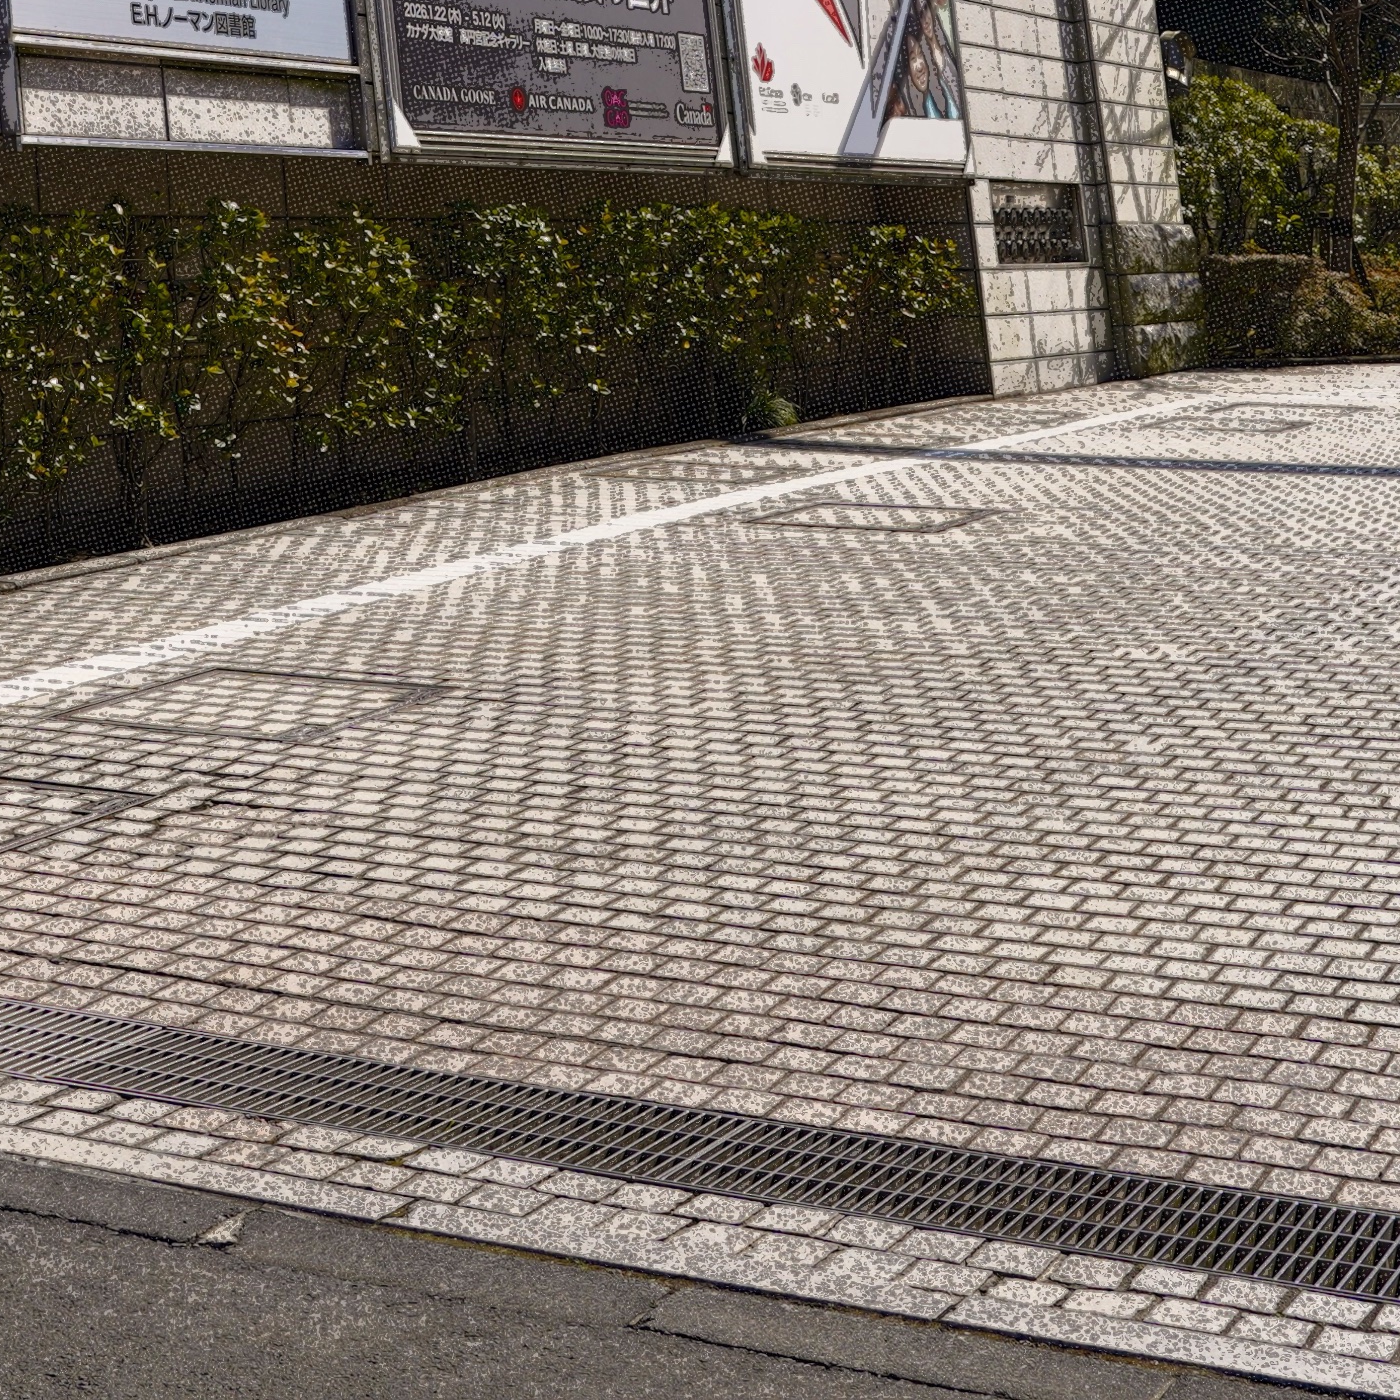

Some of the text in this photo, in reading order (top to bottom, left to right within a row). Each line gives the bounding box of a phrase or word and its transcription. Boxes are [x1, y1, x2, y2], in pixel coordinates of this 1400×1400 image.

[412, 85, 496, 105] CANADA GOOSE
[528, 94, 593, 112] AIR CANADA
[676, 102, 713, 126] Canada
